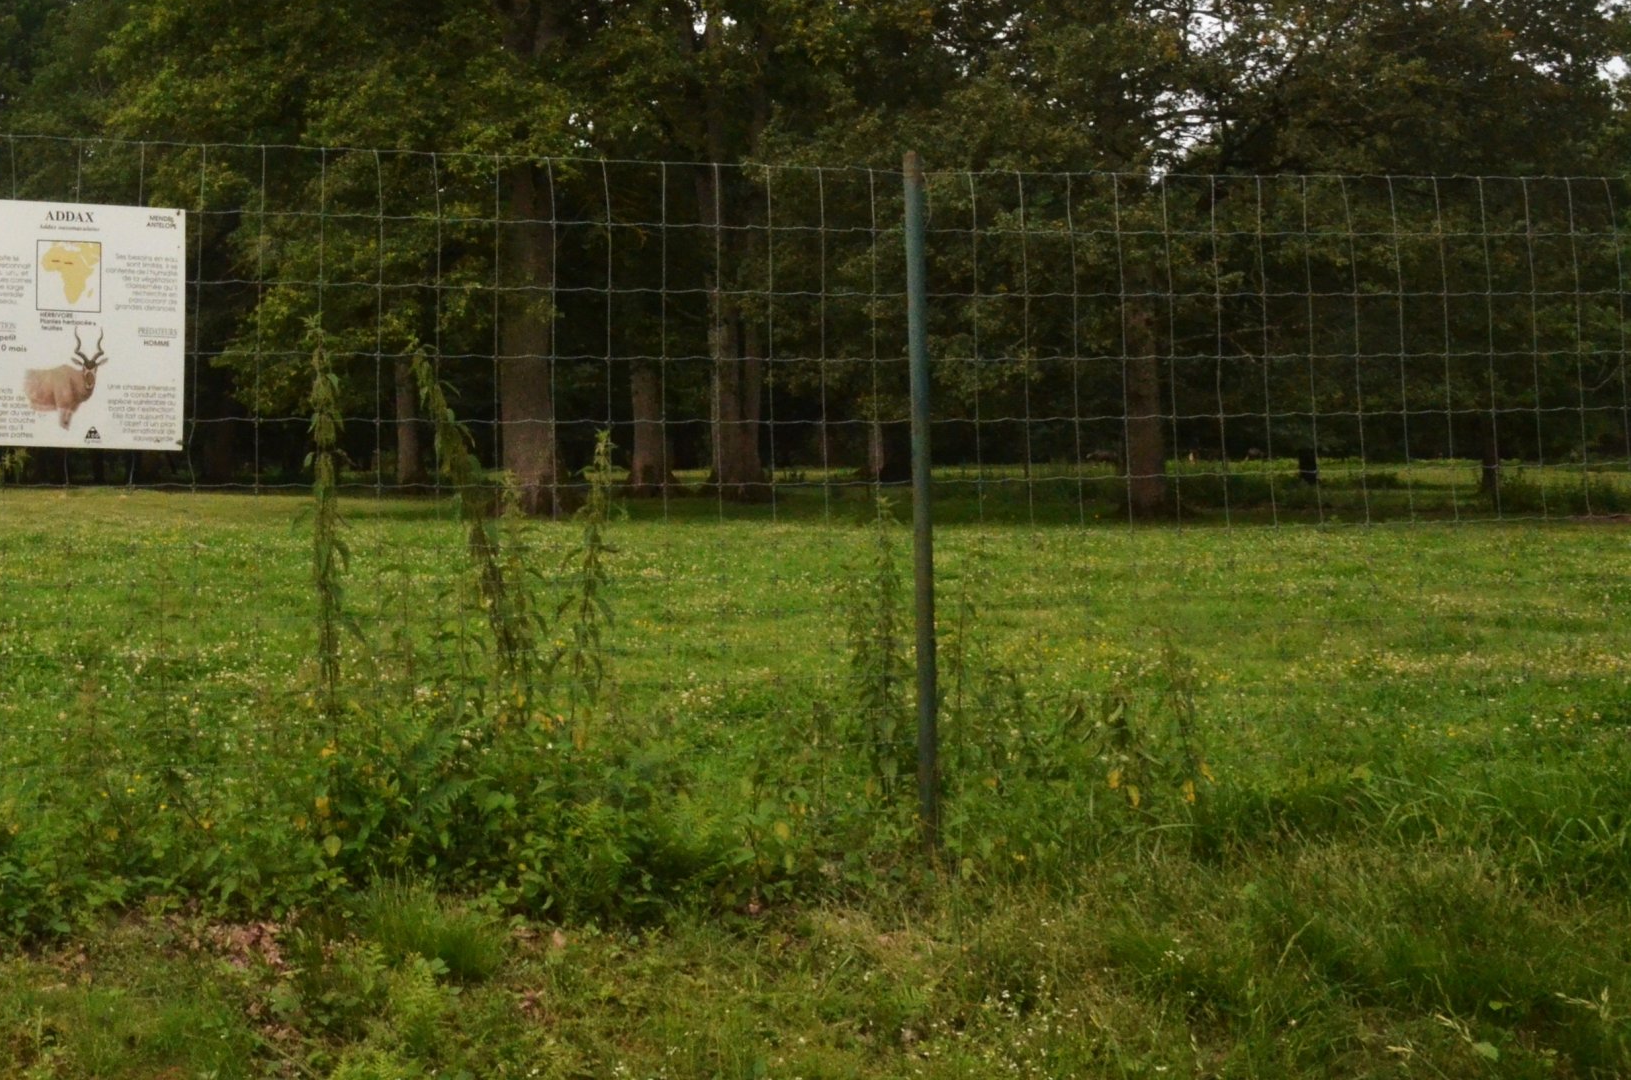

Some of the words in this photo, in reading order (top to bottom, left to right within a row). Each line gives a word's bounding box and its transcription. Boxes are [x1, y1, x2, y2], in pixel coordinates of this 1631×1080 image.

[45, 210, 94, 223] ADDAX
[128, 254, 152, 262] besoins
[114, 303, 143, 312] grandes
[0, 333, 17, 342] petit
[144, 339, 170, 347] HOMME
[8, 416, 36, 424] couche
[160, 421, 176, 430] plan
[122, 427, 166, 436] international
